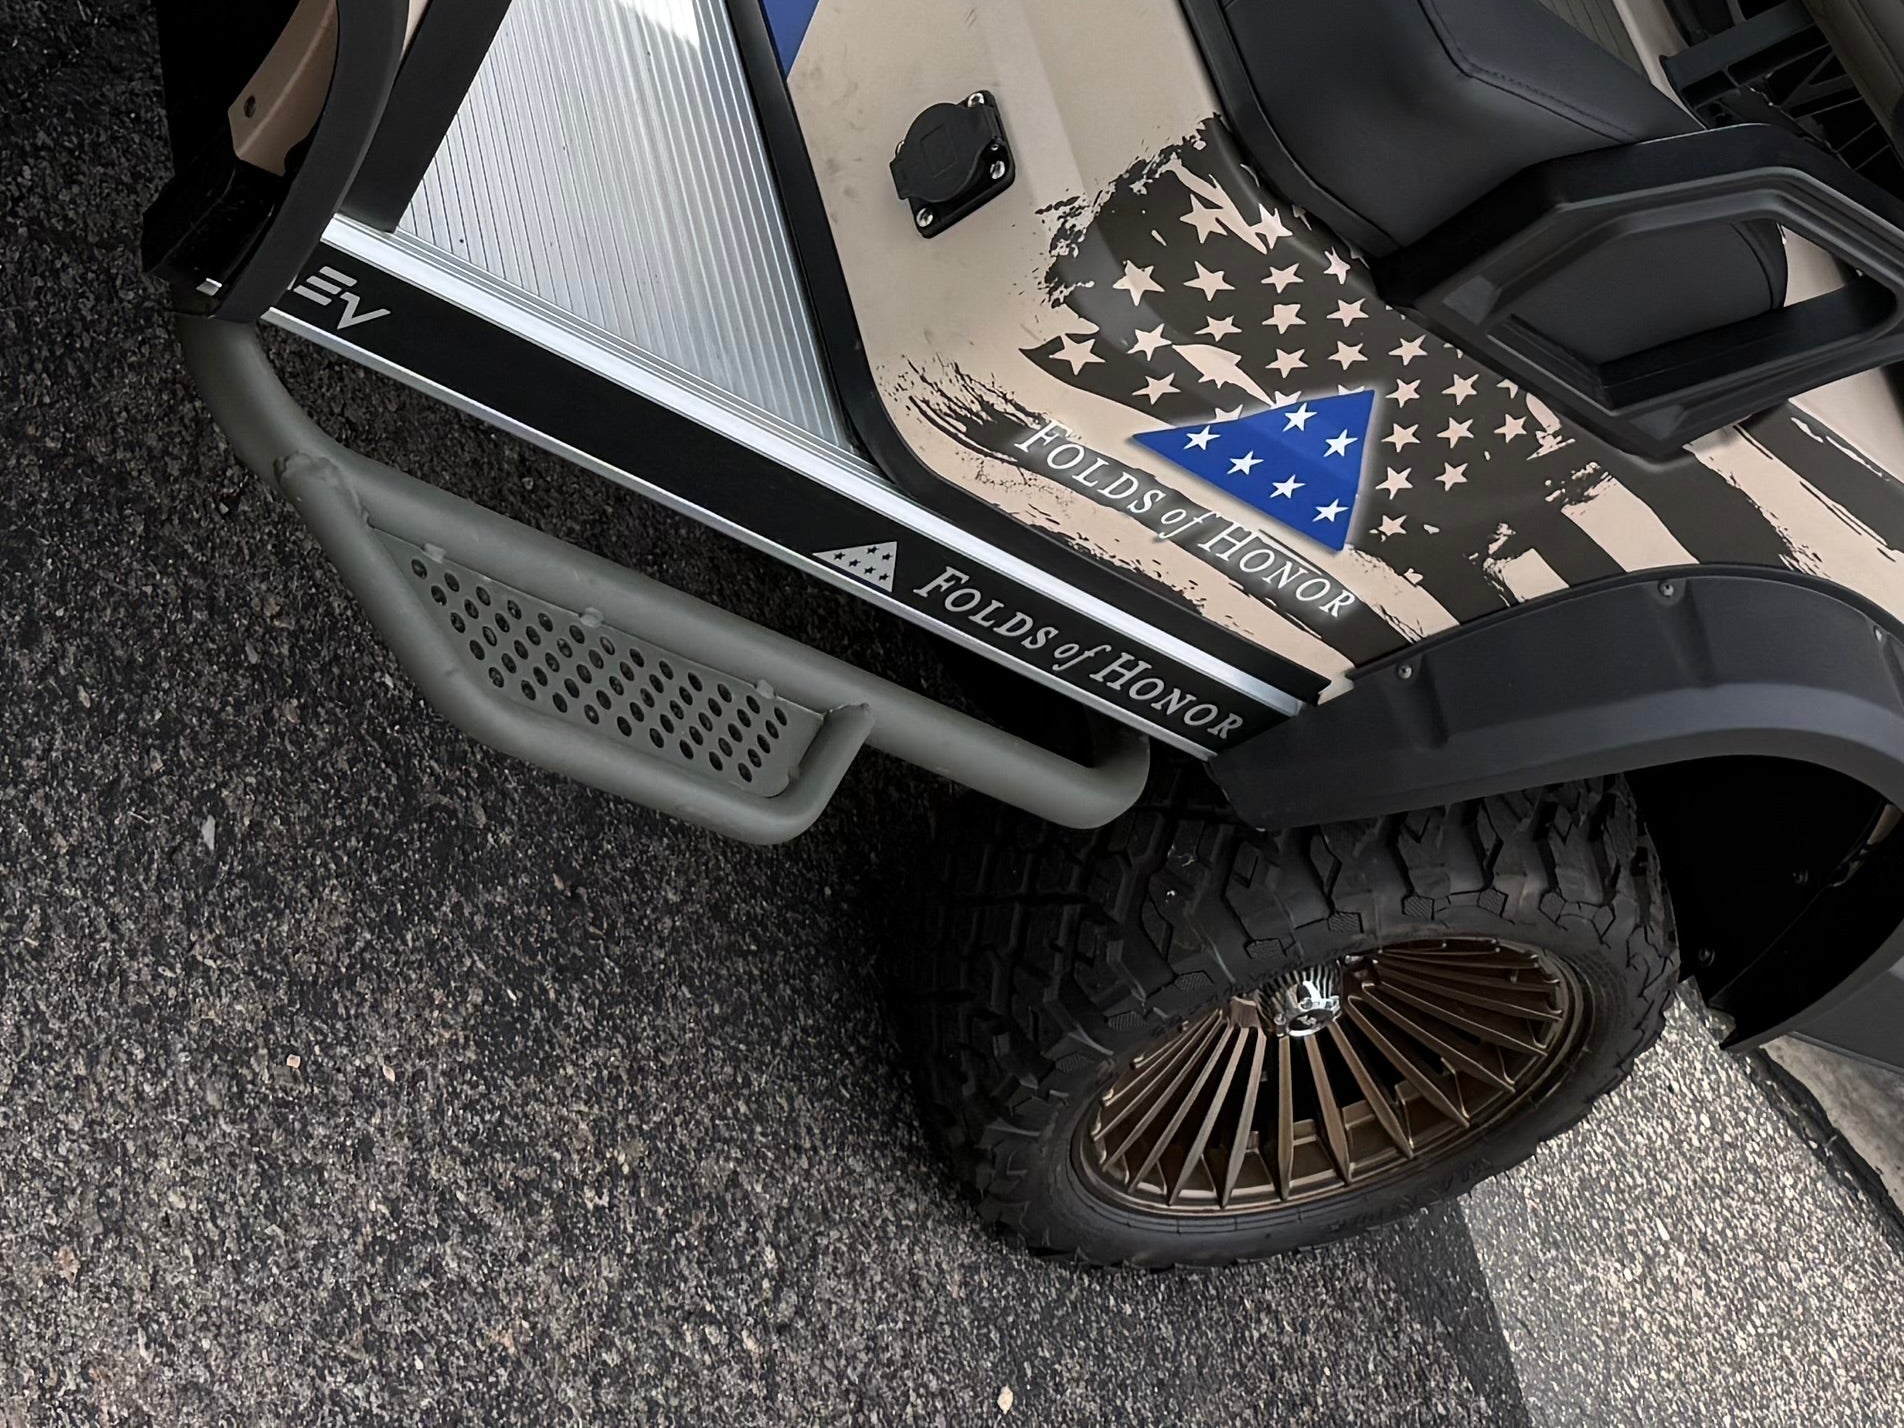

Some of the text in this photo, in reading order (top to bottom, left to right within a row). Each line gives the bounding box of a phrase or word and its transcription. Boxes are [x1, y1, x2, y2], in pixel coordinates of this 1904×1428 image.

[288, 266, 391, 330] EV
[1014, 418, 1356, 618] FOLDS of HONOR
[913, 566, 1244, 740] FOLDS of HONOR
